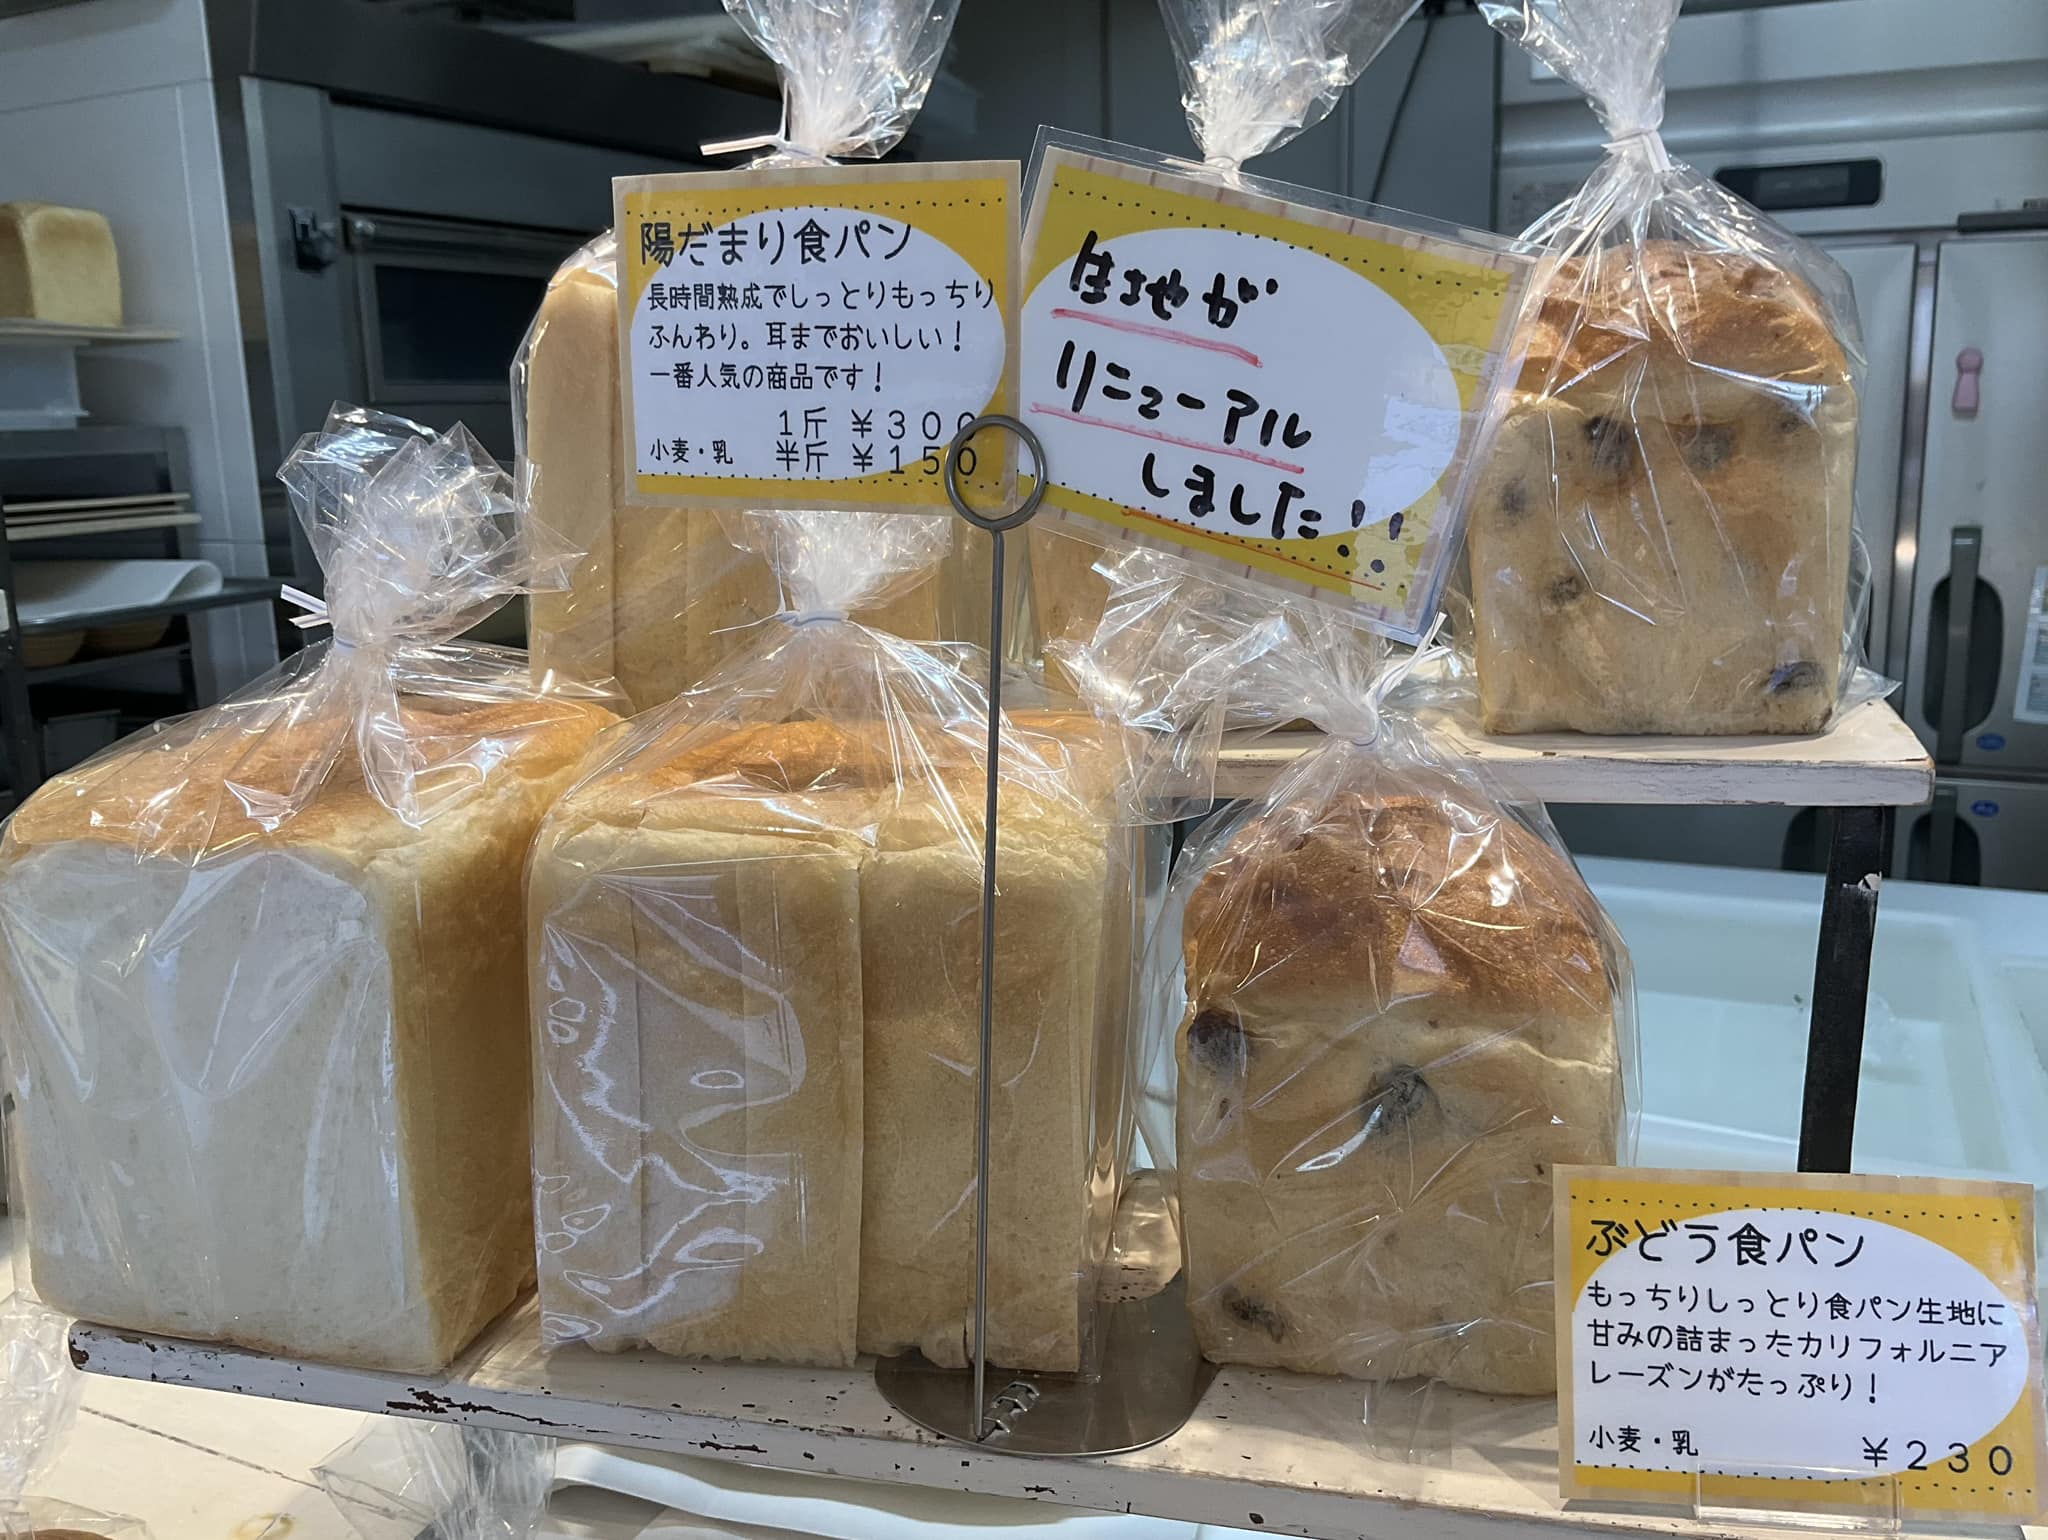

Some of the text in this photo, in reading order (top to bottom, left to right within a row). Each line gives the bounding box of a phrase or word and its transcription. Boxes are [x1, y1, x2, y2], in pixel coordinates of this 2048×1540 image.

[640, 218, 913, 266] 陽だまり食パン
[647, 279, 994, 310] 長時間熟成でしっとりもっちり
[1069, 230, 1279, 328] 生地が
[649, 362, 883, 392] 一番人気の商品です！
[1056, 340, 1312, 449] リニューアル
[778, 407, 829, 437] 1斤
[649, 438, 978, 476] 小麦・乳 半斤 ¥150
[1586, 1219, 1865, 1268] ぶどう食パン
[1587, 1280, 2004, 1327] もっちりしっとり食パン生地に
[1587, 1319, 2008, 1368] 甘みの詰まったカリフォルニア
[1591, 1360, 1879, 1404] レーズンがたっぷり！
[1588, 1425, 2014, 1476] 小麦・乳 ¥230
